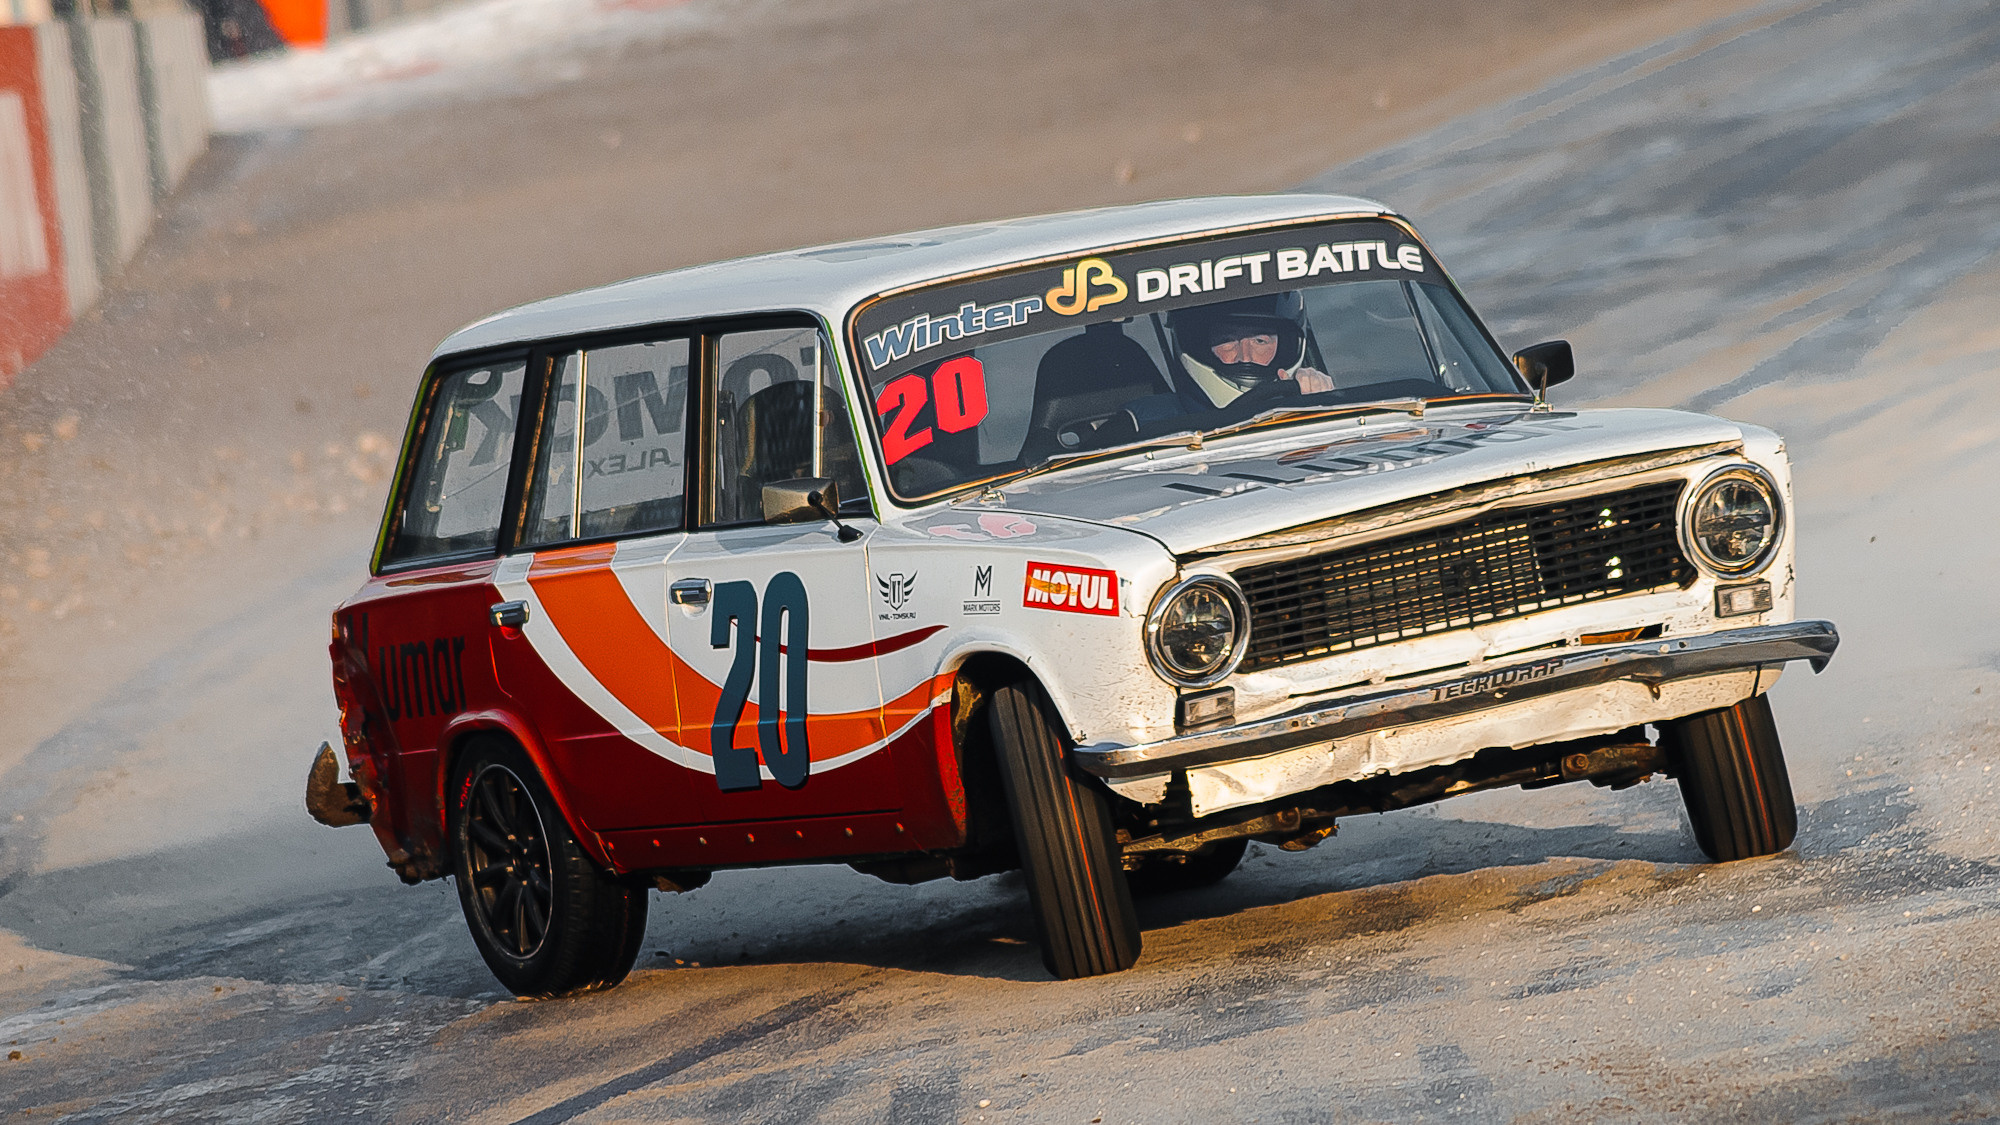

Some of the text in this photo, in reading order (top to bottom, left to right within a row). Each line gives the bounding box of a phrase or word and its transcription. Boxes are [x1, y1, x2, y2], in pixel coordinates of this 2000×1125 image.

[864, 296, 1042, 371] Winter
[1136, 251, 1271, 303] DRIFT
[1276, 240, 1425, 281] BATTLE
[876, 355, 989, 466] 20
[1026, 568, 1114, 611] MOTUL
[710, 571, 811, 793] 20
[1430, 659, 1564, 702] TECKWRAP
